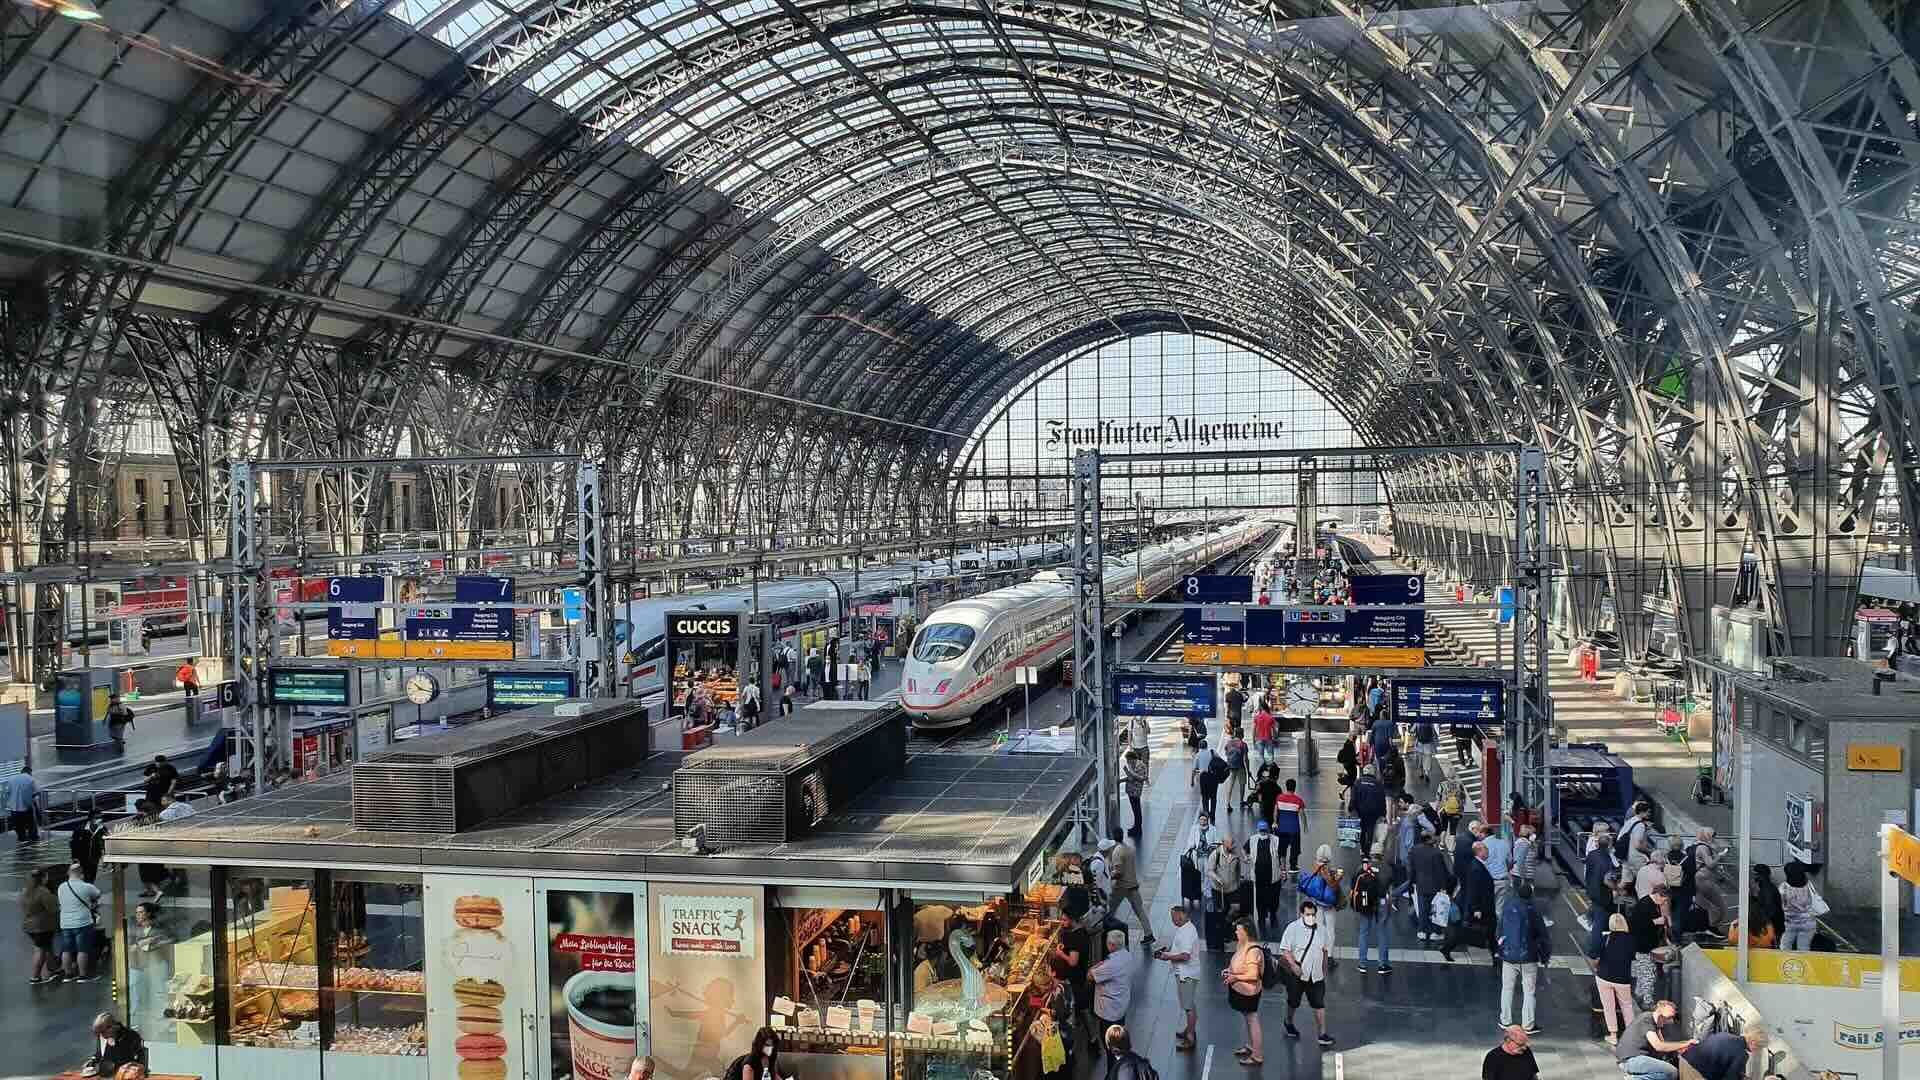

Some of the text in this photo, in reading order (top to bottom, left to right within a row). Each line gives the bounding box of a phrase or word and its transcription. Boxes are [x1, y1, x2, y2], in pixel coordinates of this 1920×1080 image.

[1046, 415, 1283, 451] Frankfurter Allgemeine
[330, 579, 341, 596] 6
[499, 579, 510, 596] 7
[1187, 577, 1199, 596] 8
[1408, 577, 1421, 596] 9
[1292, 612, 1300, 621] U
[1331, 612, 1339, 620] S
[676, 620, 731, 634] CUCCIS
[224, 684, 232, 702] 6
[672, 909, 721, 920] TRAFFIC
[672, 921, 721, 936] SNACK
[1839, 1032, 1869, 1045] rail
[1874, 1031, 1884, 1044] &
